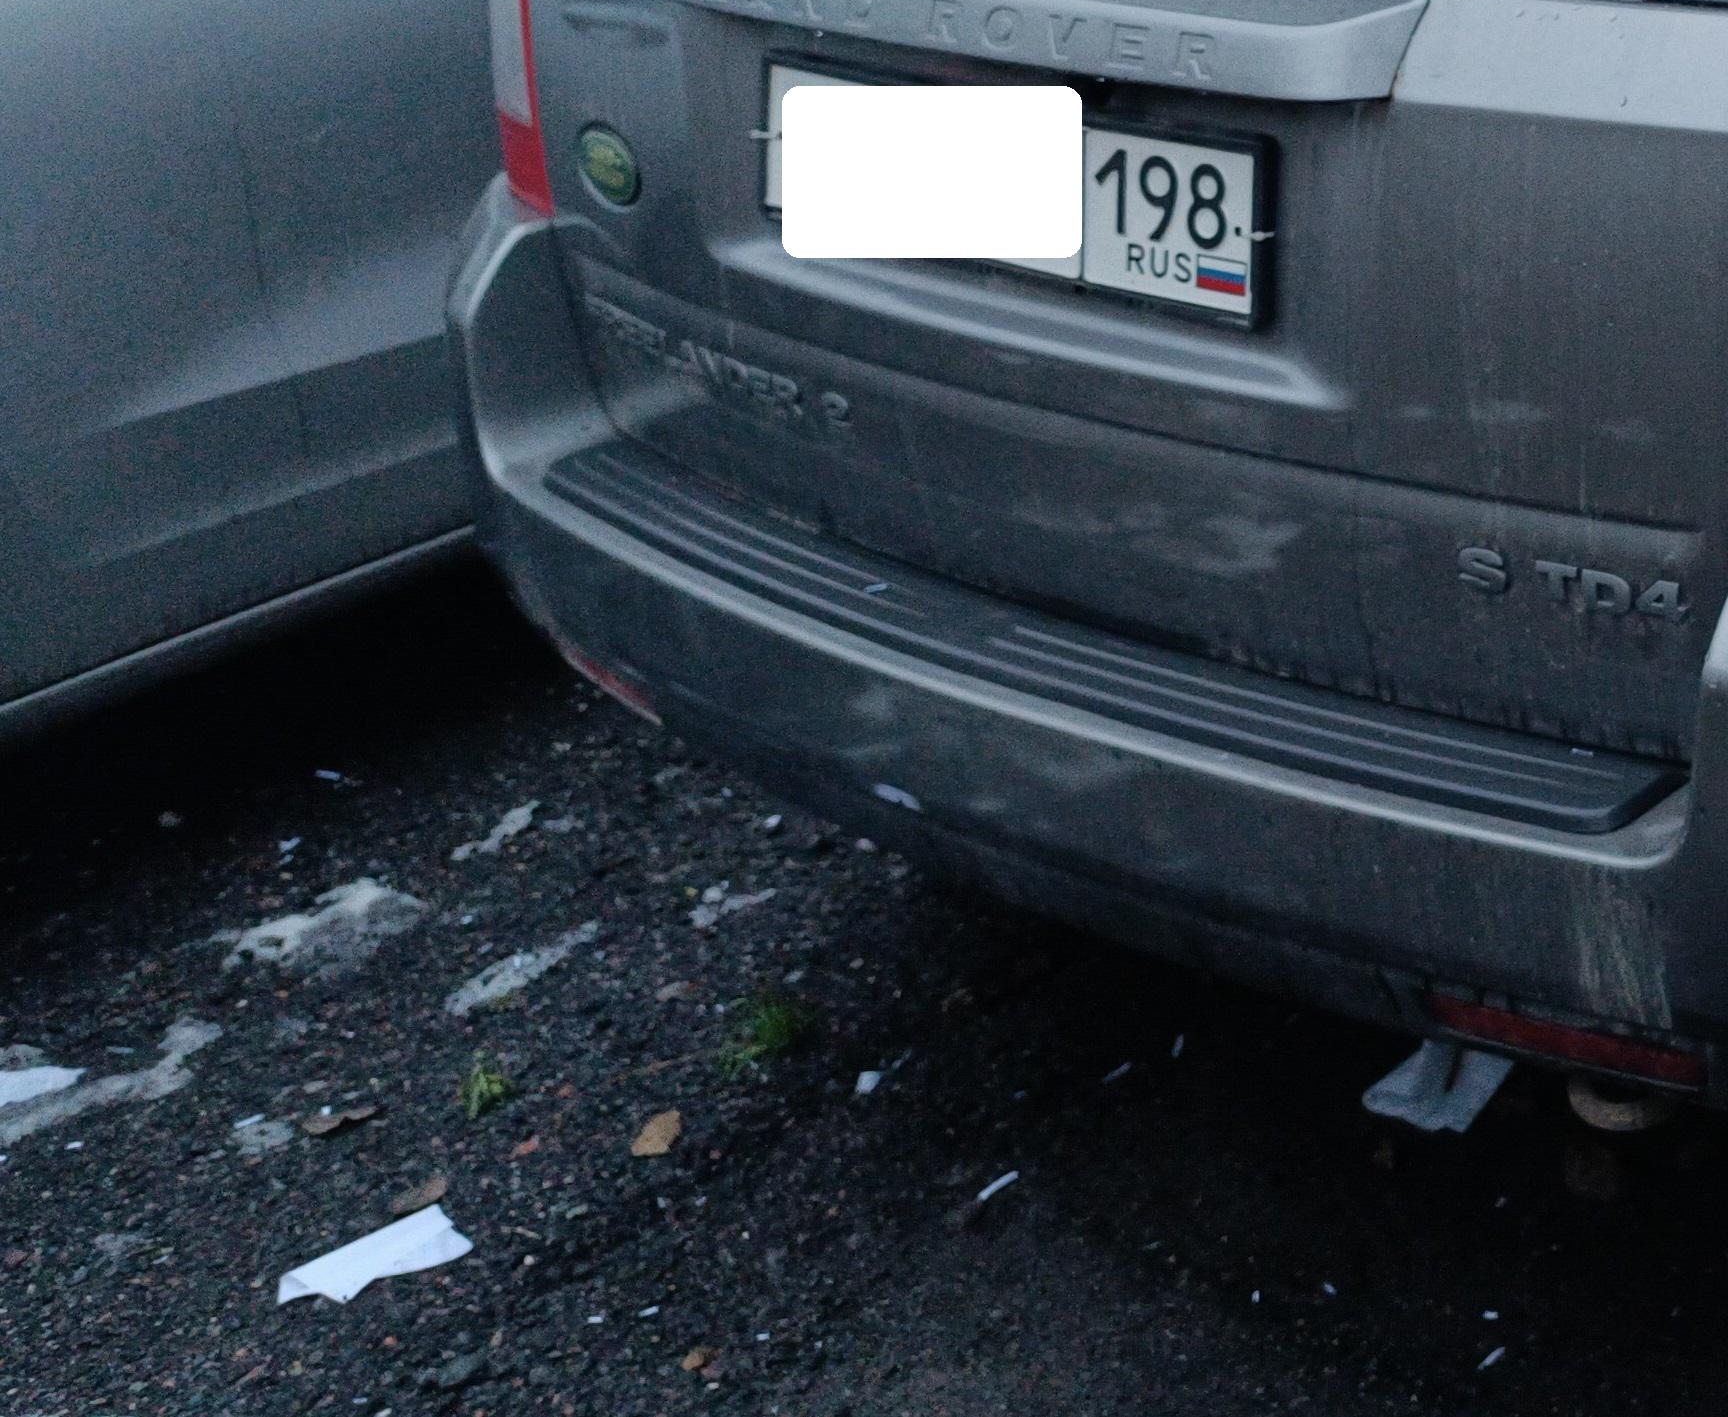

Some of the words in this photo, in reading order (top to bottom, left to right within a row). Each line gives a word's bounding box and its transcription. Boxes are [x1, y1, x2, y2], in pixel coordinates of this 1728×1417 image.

[1095, 149, 1227, 250] 198
[1127, 243, 1192, 283] RUS
[1457, 546, 1507, 593] S
[1535, 559, 1689, 620] TD4
